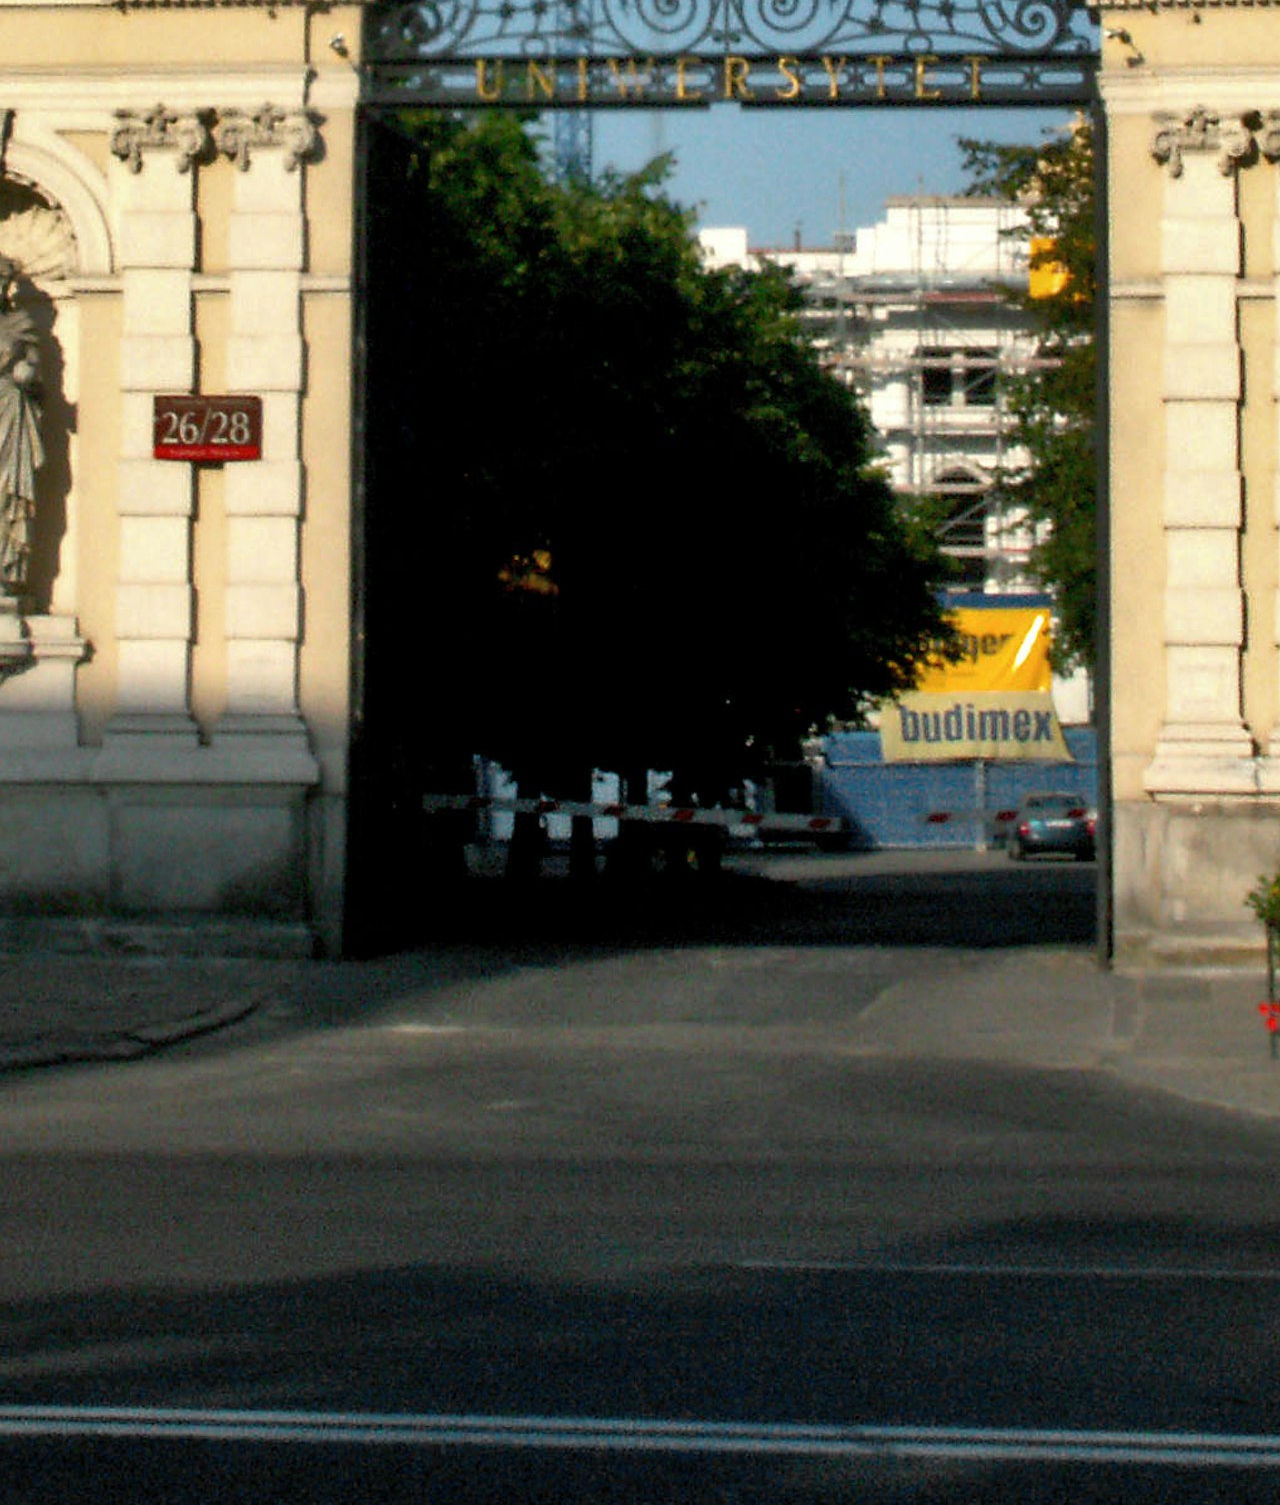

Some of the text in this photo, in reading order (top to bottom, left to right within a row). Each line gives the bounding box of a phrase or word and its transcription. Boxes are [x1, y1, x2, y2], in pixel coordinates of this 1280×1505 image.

[475, 56, 989, 99] UNIWERSYTET
[163, 408, 250, 444] 26/28
[899, 703, 1052, 742] budimex
